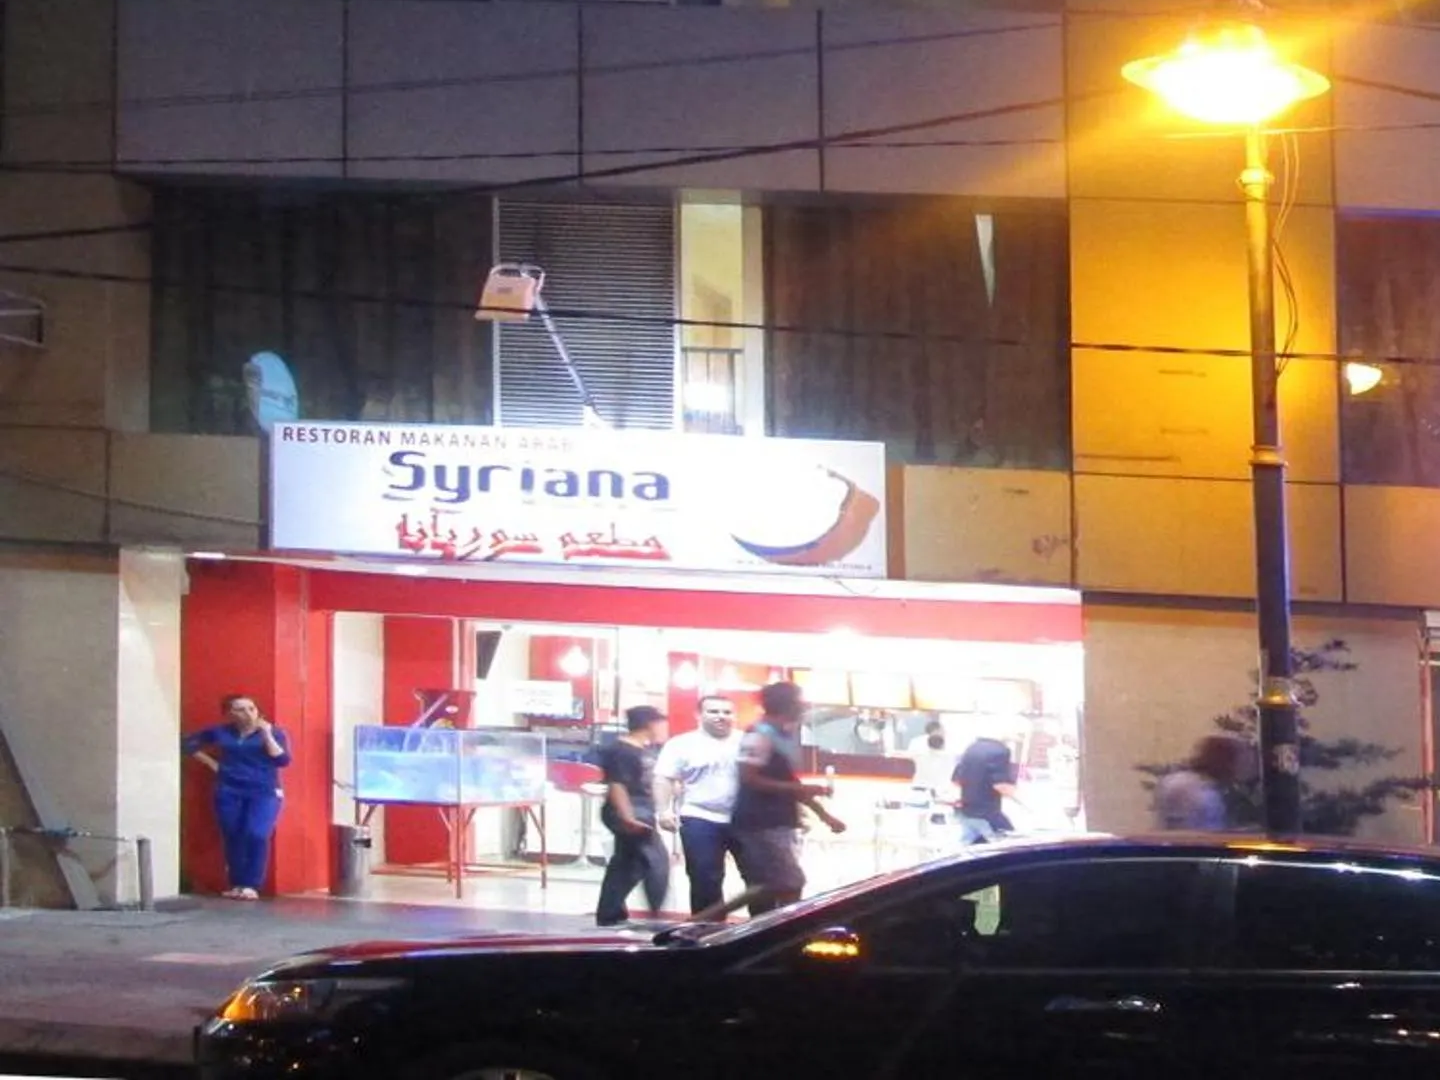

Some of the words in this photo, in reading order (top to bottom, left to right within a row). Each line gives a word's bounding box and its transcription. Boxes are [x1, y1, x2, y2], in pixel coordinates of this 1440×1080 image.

[282, 425, 392, 445] RESTORAN
[400, 430, 508, 450] MAKANAN
[384, 450, 672, 504] Syriana
